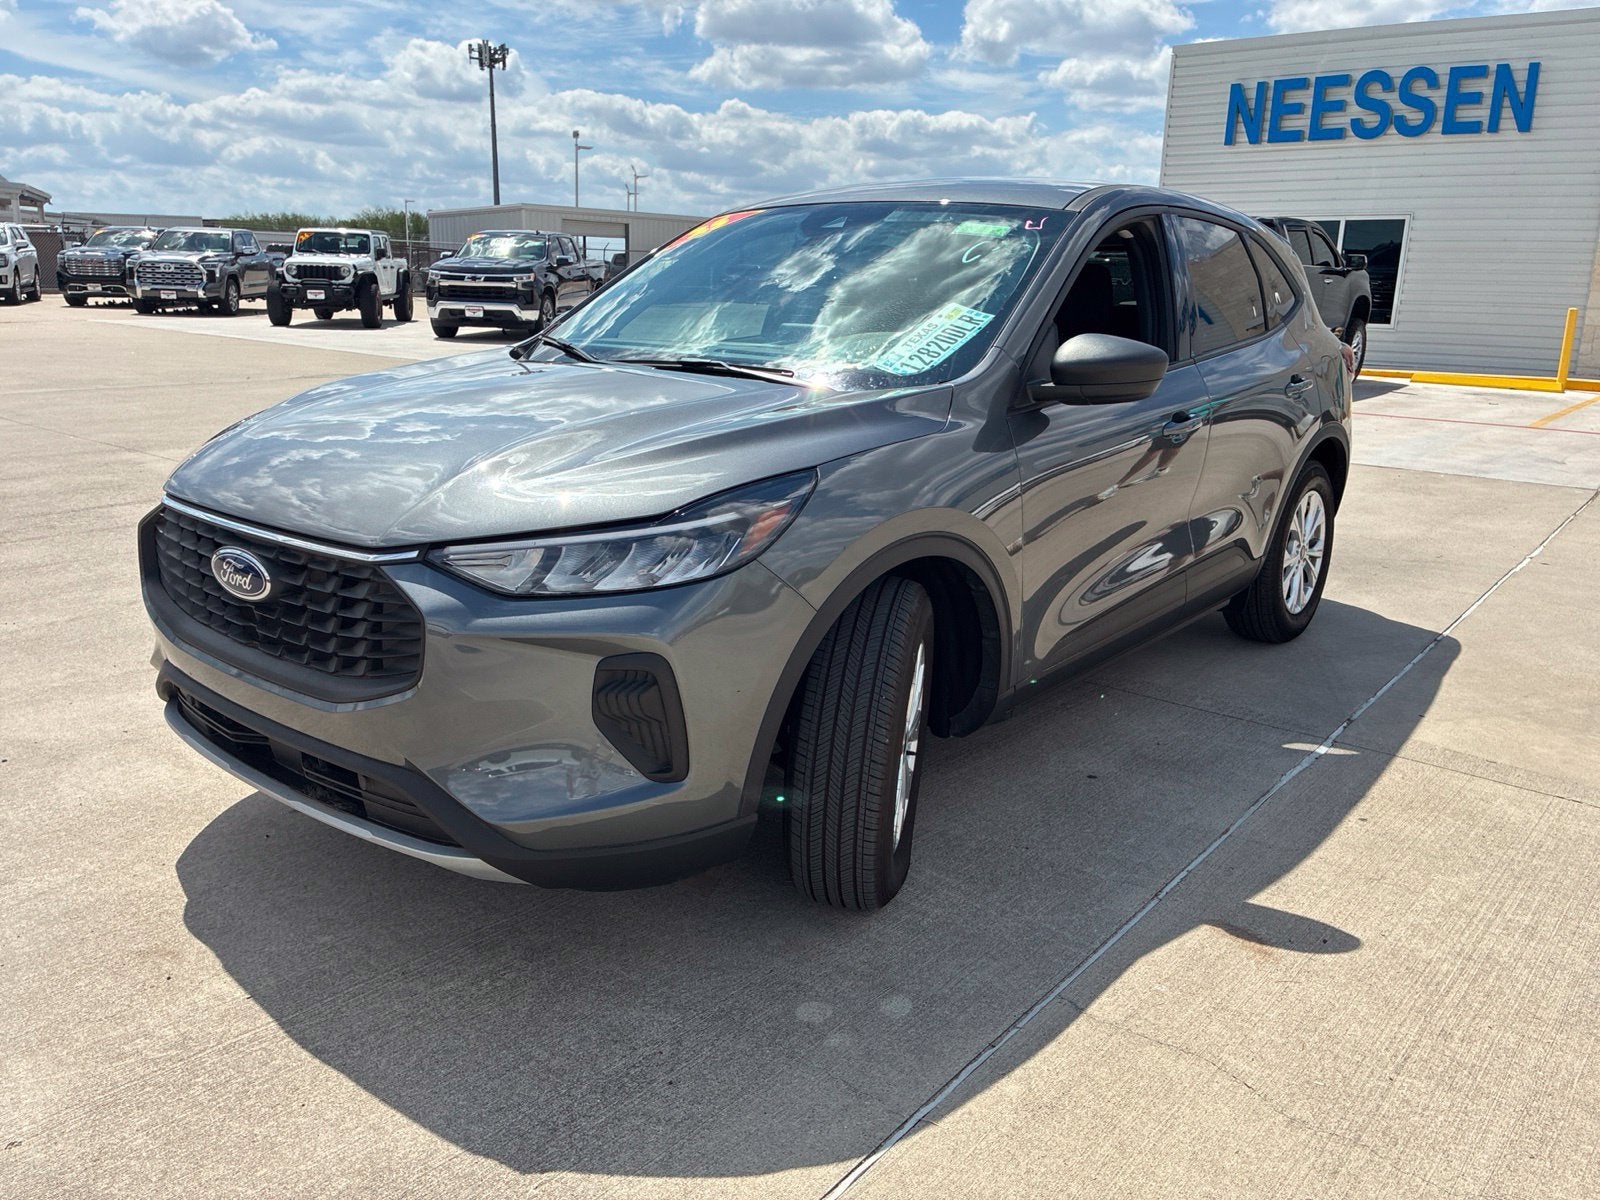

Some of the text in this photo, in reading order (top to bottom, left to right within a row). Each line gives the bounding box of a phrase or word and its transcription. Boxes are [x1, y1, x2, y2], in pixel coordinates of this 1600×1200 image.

[1223, 62, 1541, 146] NEESSEN
[901, 322, 938, 349] TEXAS
[220, 558, 254, 591] Ford
